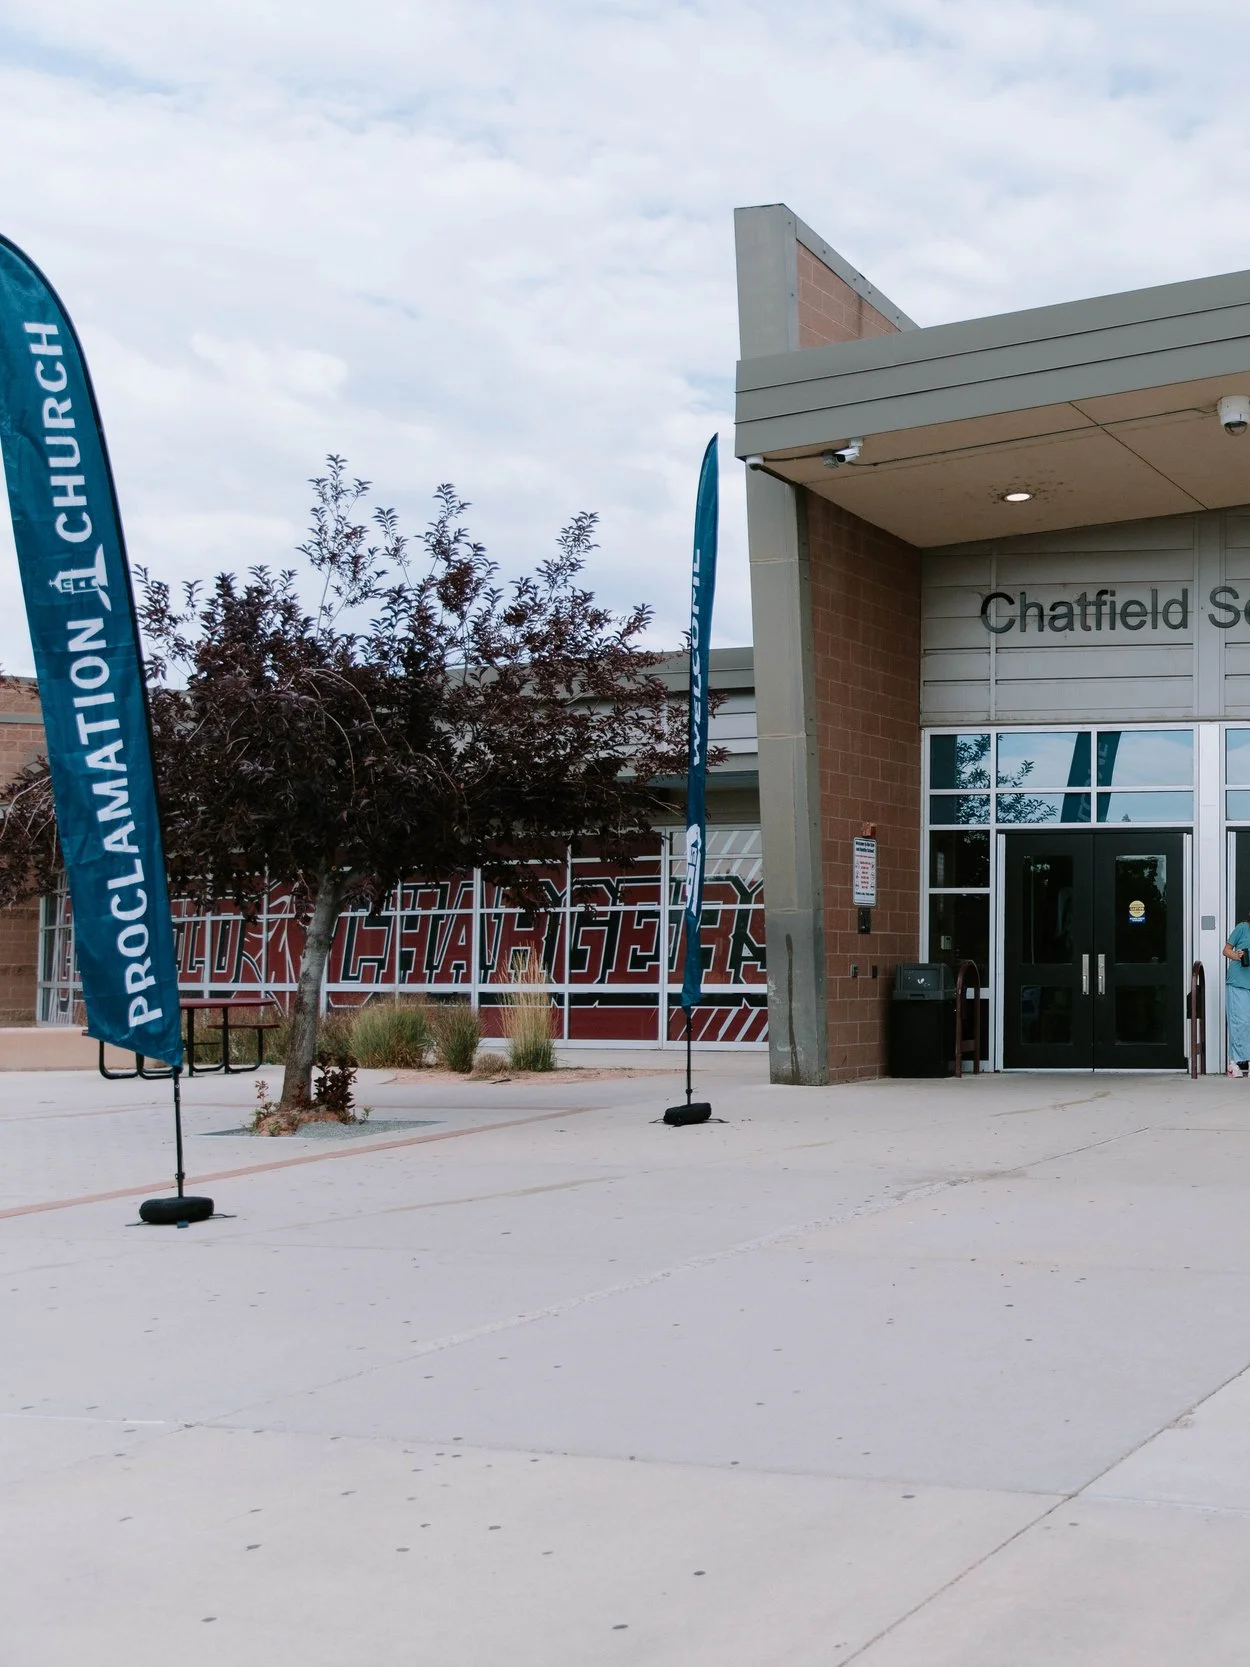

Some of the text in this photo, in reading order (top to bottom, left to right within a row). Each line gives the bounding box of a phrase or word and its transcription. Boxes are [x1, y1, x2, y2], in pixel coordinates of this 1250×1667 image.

[24, 322, 92, 544] CHURCH
[980, 588, 1189, 634] Chatfield
[67, 617, 163, 1028] PROCLAMATION
